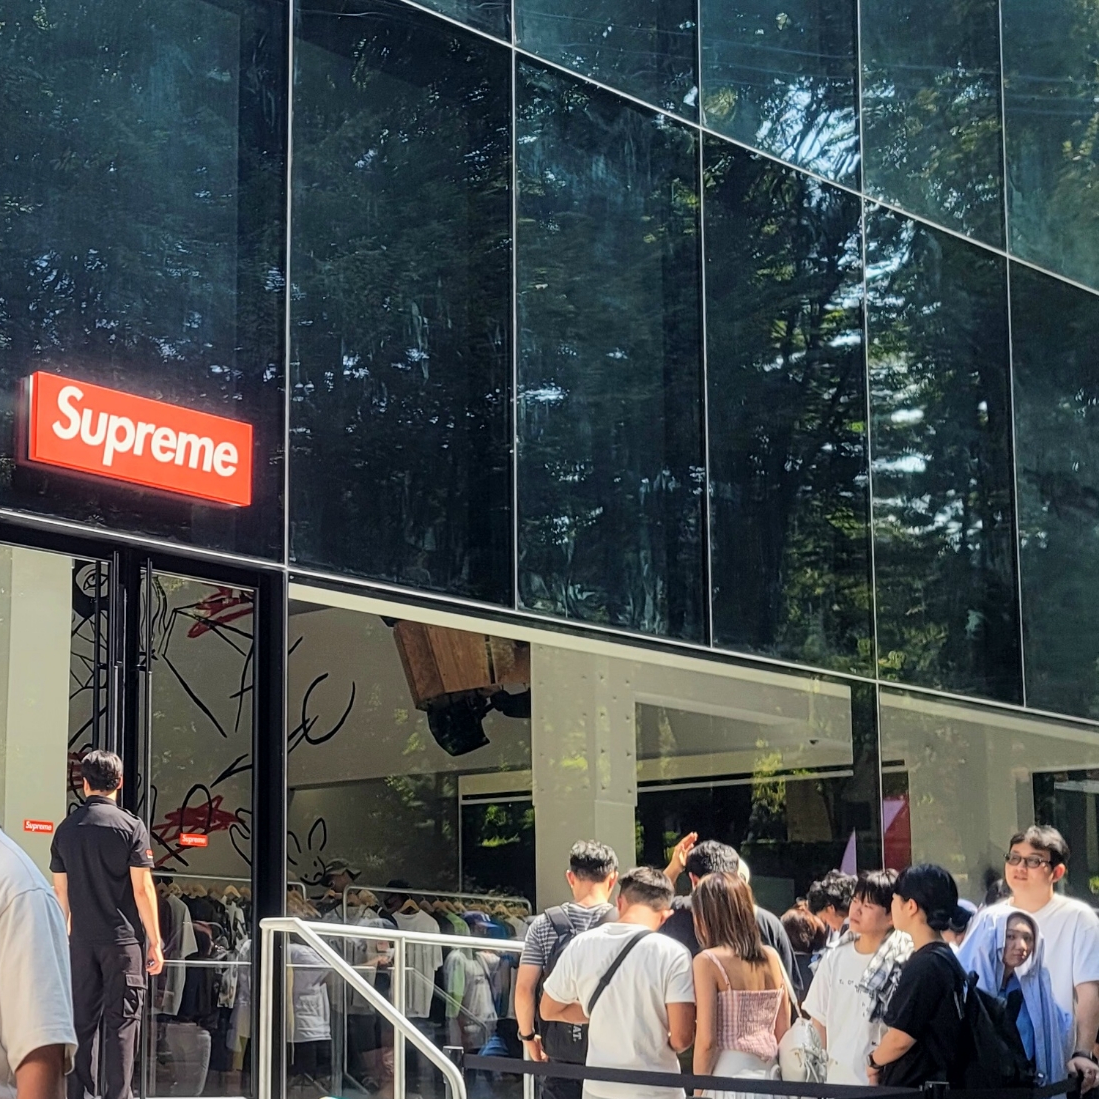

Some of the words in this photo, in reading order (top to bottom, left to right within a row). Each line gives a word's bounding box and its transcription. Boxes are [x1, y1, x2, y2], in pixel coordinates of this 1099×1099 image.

[51, 385, 239, 477] Supreme
[25, 820, 52, 832] Supreme
[572, 1023, 583, 1043] AT.
